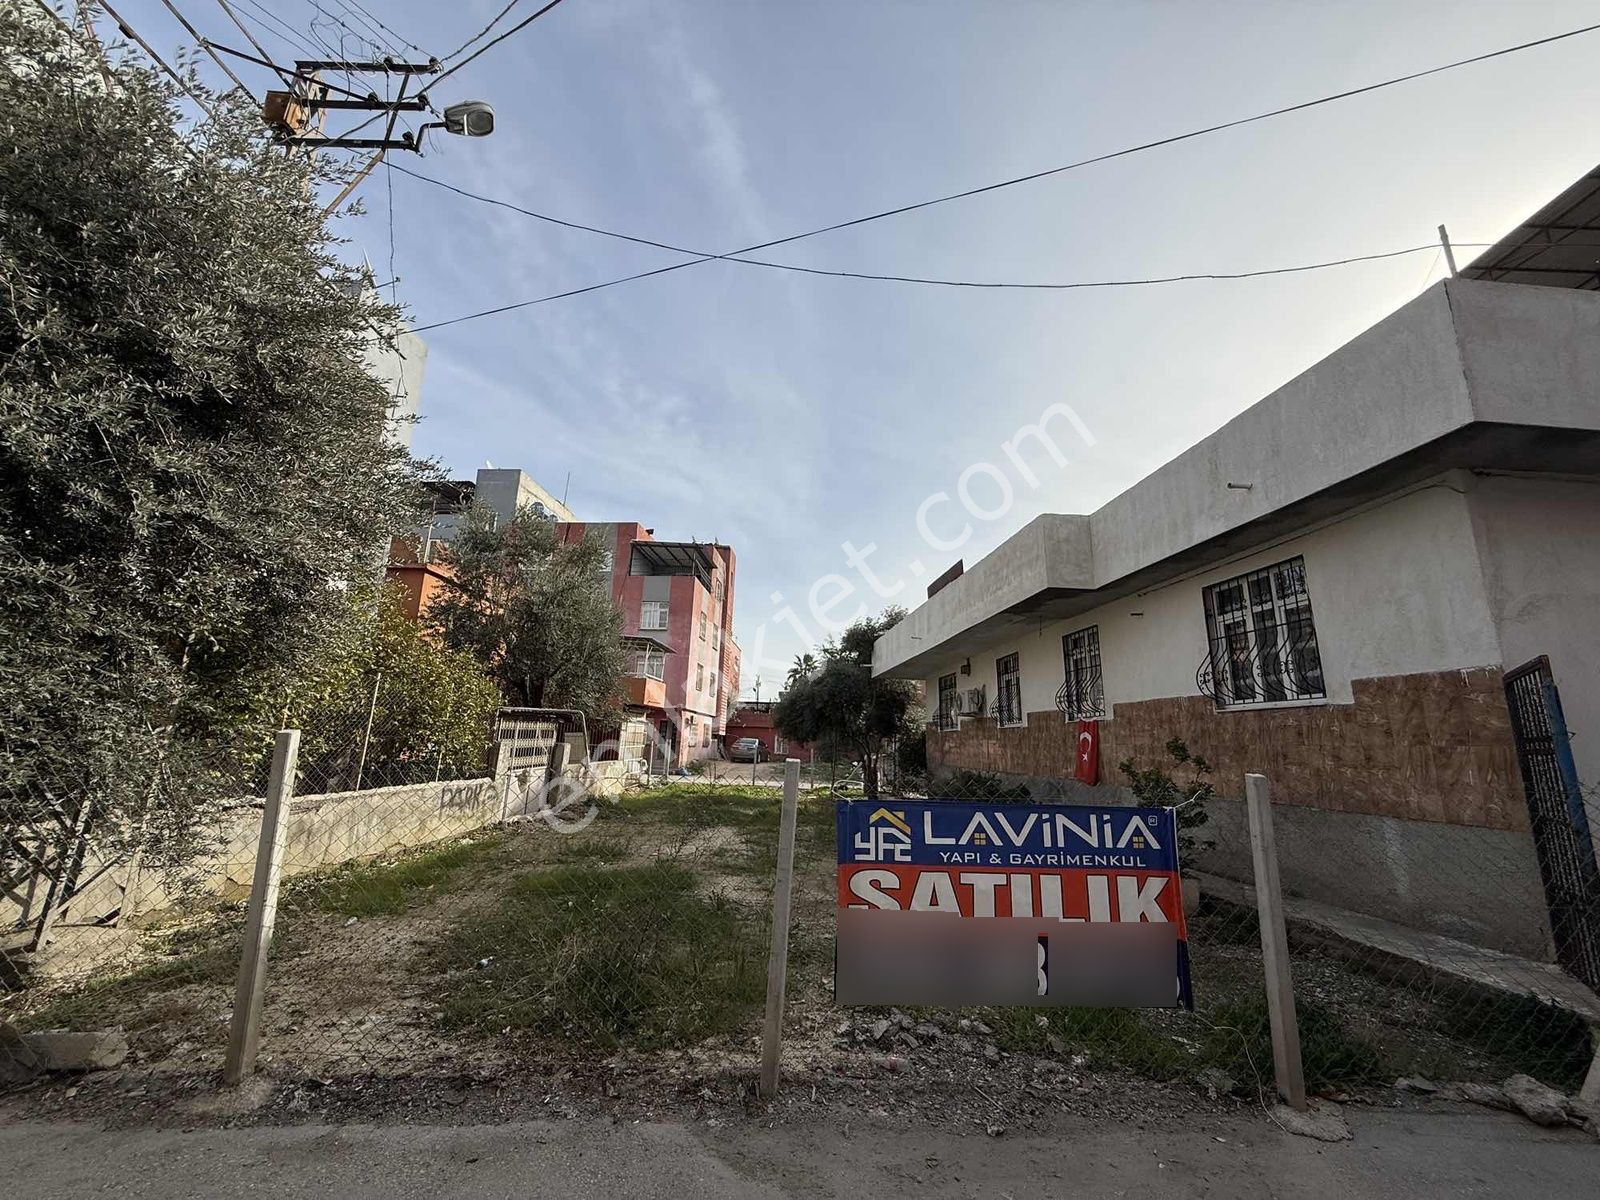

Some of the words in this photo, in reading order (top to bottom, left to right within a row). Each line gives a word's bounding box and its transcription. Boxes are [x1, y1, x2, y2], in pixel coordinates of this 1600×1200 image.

[940, 852, 981, 864] YAPI
[989, 853, 1002, 864] &
[1009, 852, 1147, 867] GAYRİMENKUL
[848, 868, 1169, 923] SATILIK
